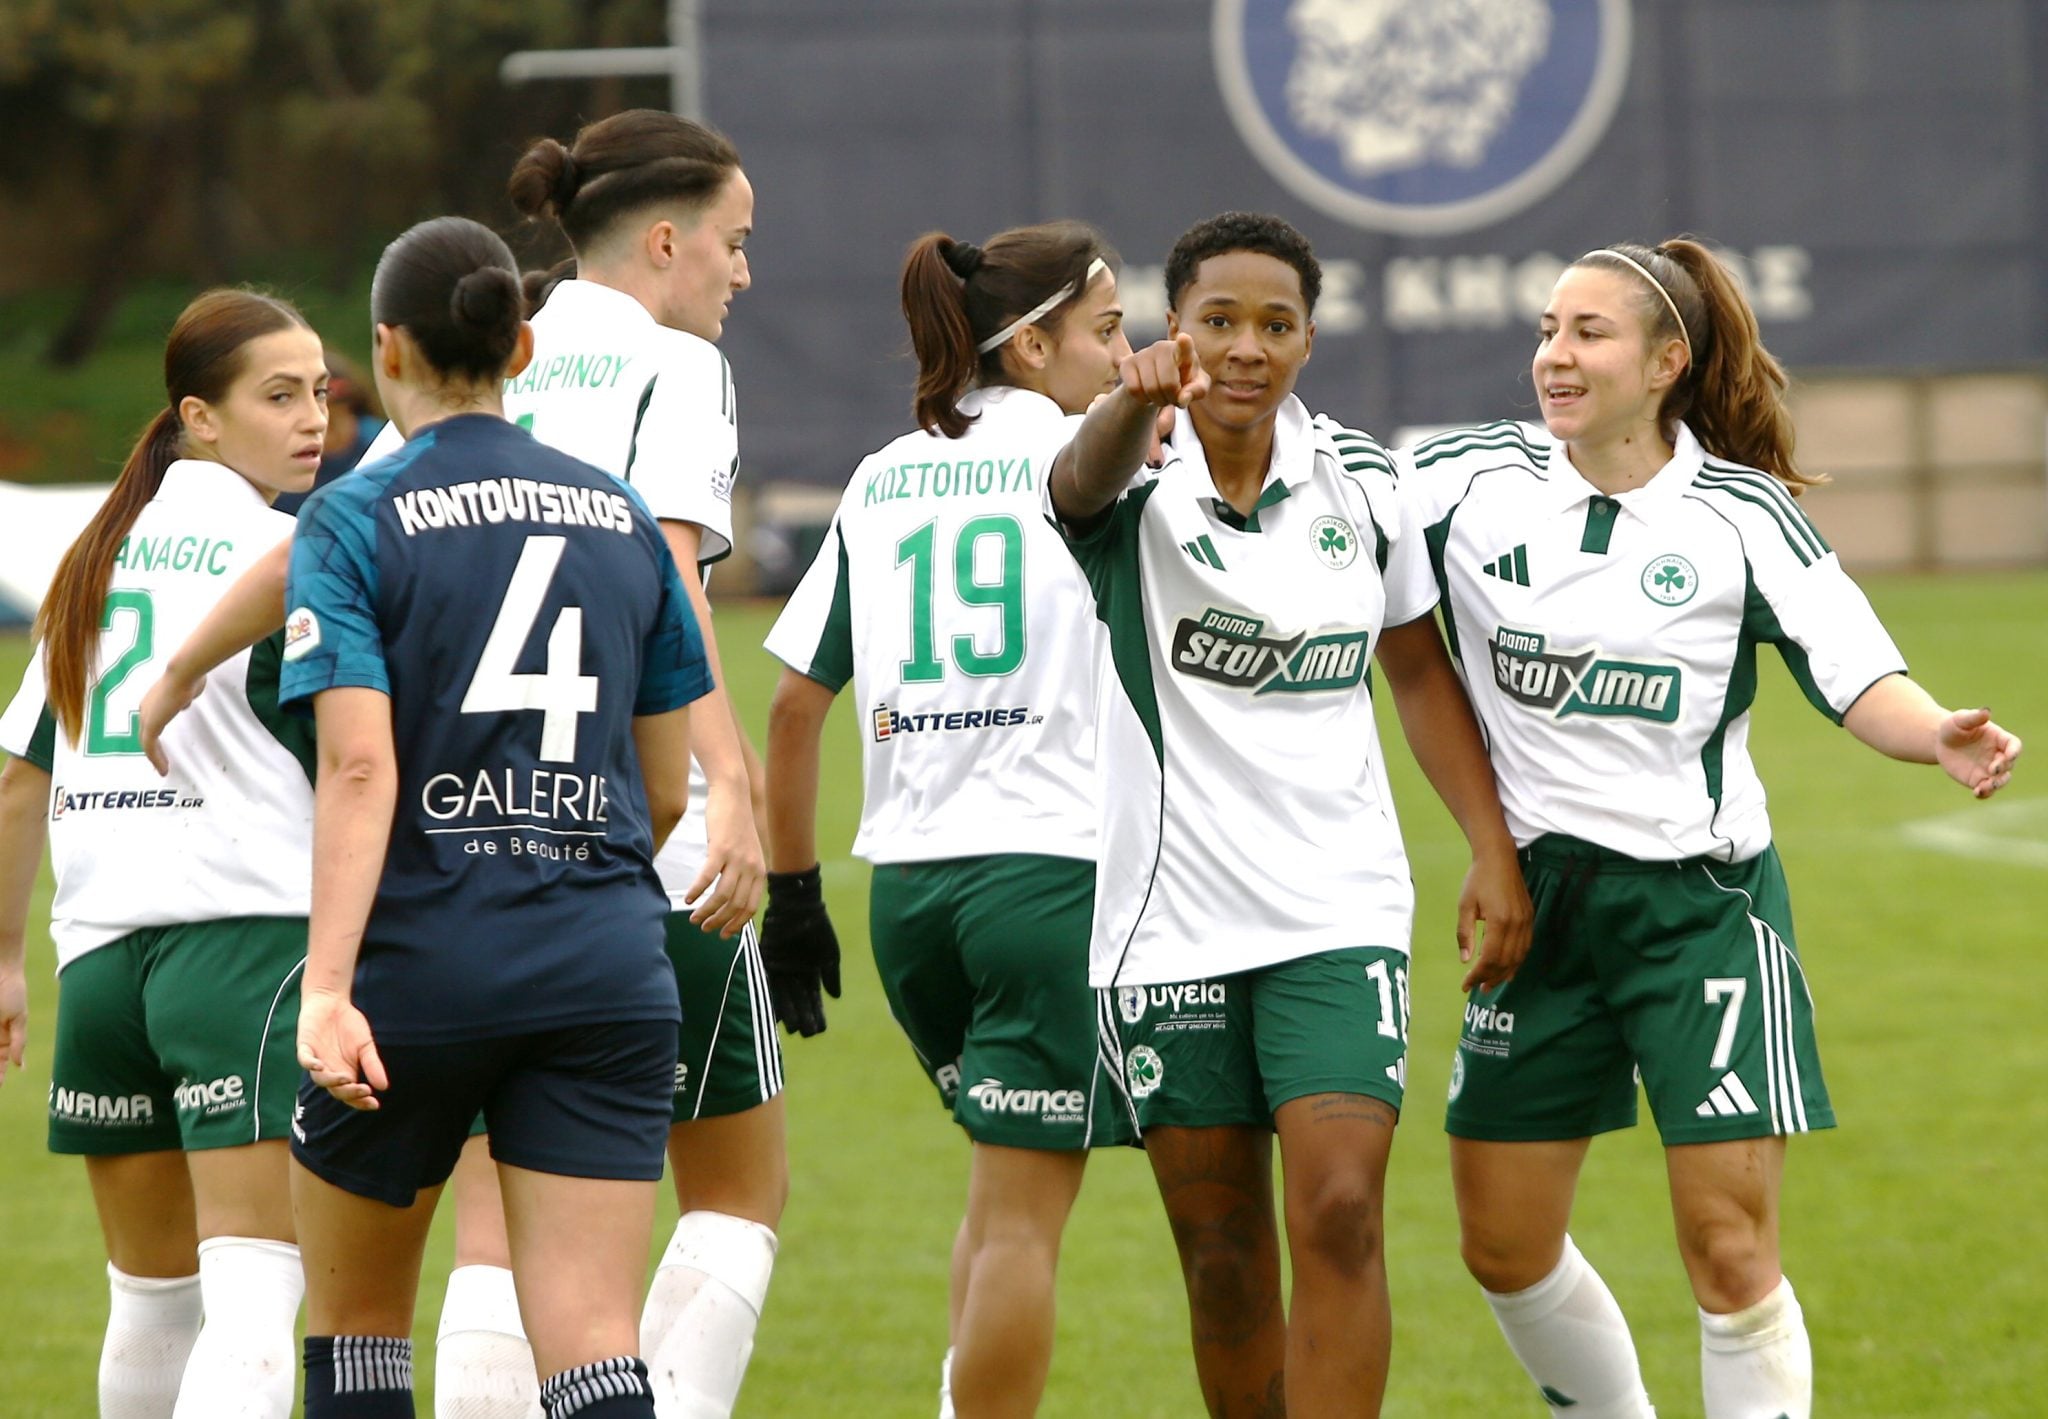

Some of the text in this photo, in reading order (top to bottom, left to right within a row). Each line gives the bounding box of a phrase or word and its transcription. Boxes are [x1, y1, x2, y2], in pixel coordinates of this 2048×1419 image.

[393, 477, 633, 536] KONTOUTSIKOS
[895, 513, 1027, 684] 19
[1204, 611, 1258, 638] pame
[459, 535, 599, 763] 4
[1498, 630, 1541, 653] pame
[83, 587, 156, 758] 2
[60, 788, 205, 813] ATTERIES.GR
[421, 767, 609, 822] GALERIE
[463, 836, 590, 861] de Beauté
[1703, 977, 1747, 1069] 7
[979, 1085, 1086, 1113] avance
